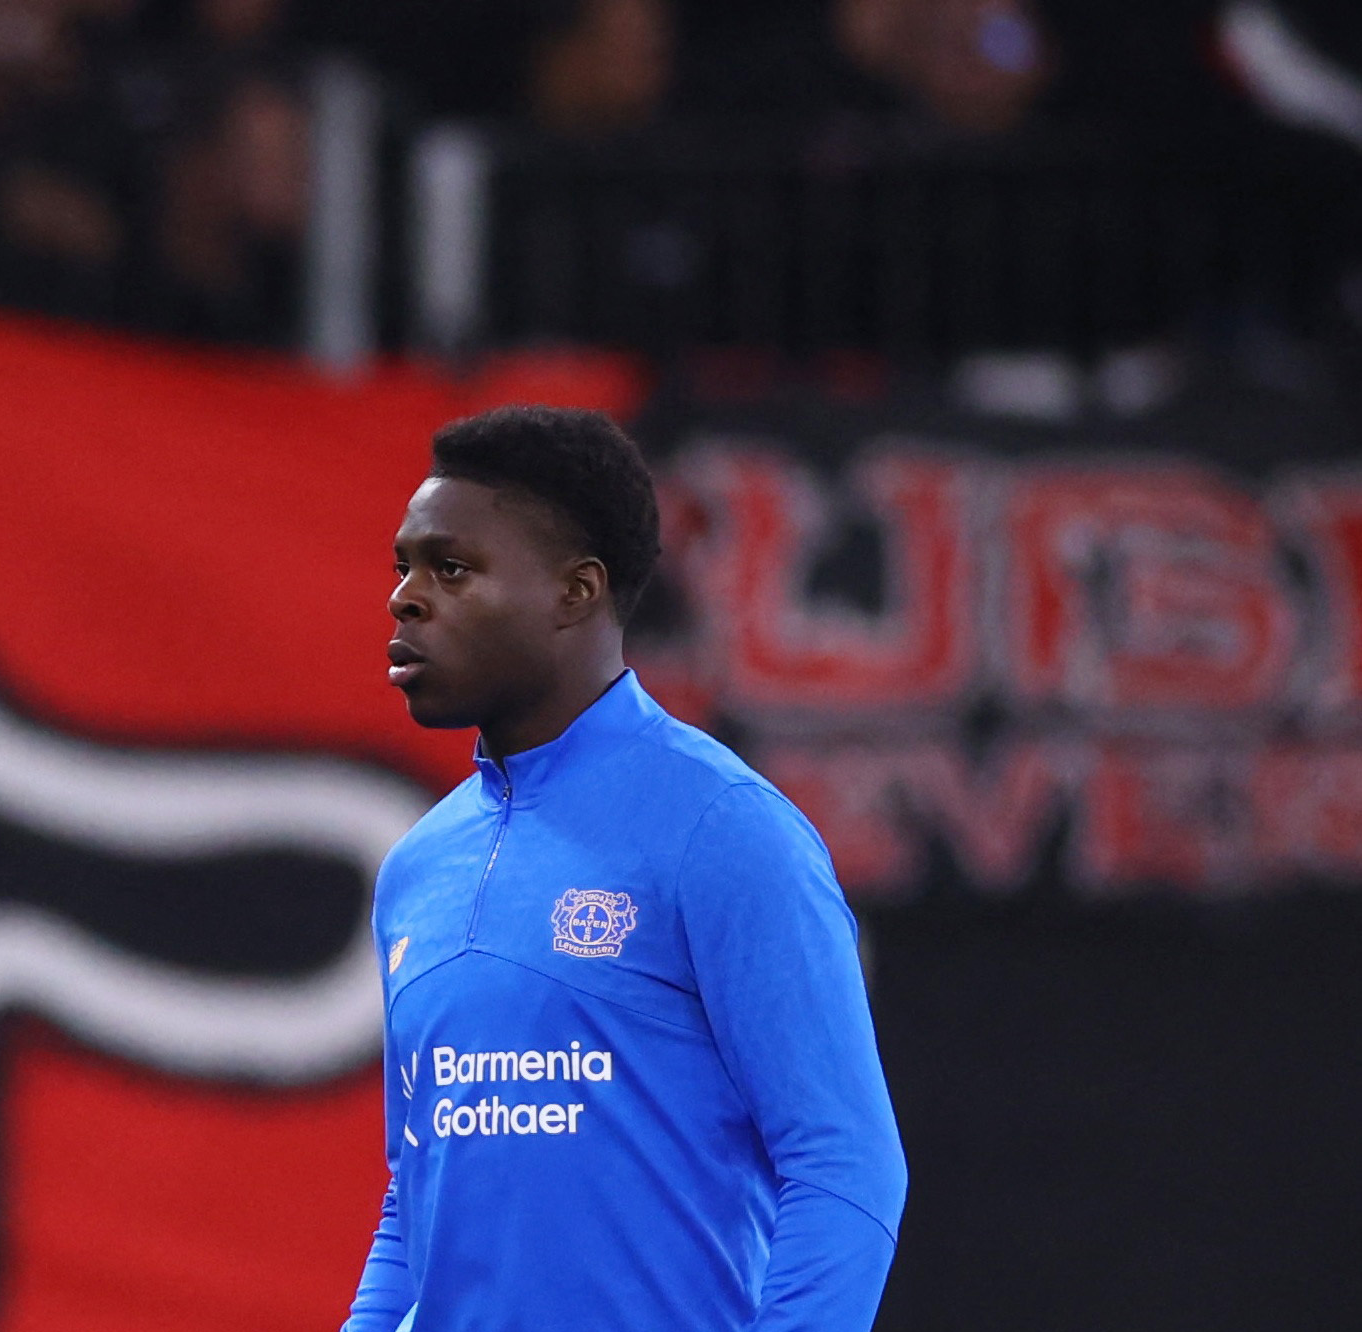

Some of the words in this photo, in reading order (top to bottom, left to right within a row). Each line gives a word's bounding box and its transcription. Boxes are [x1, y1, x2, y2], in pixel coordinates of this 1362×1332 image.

[558, 940, 615, 955] Leverkusen
[433, 1040, 612, 1087] Barmenia
[433, 1096, 584, 1138] Gothaer
